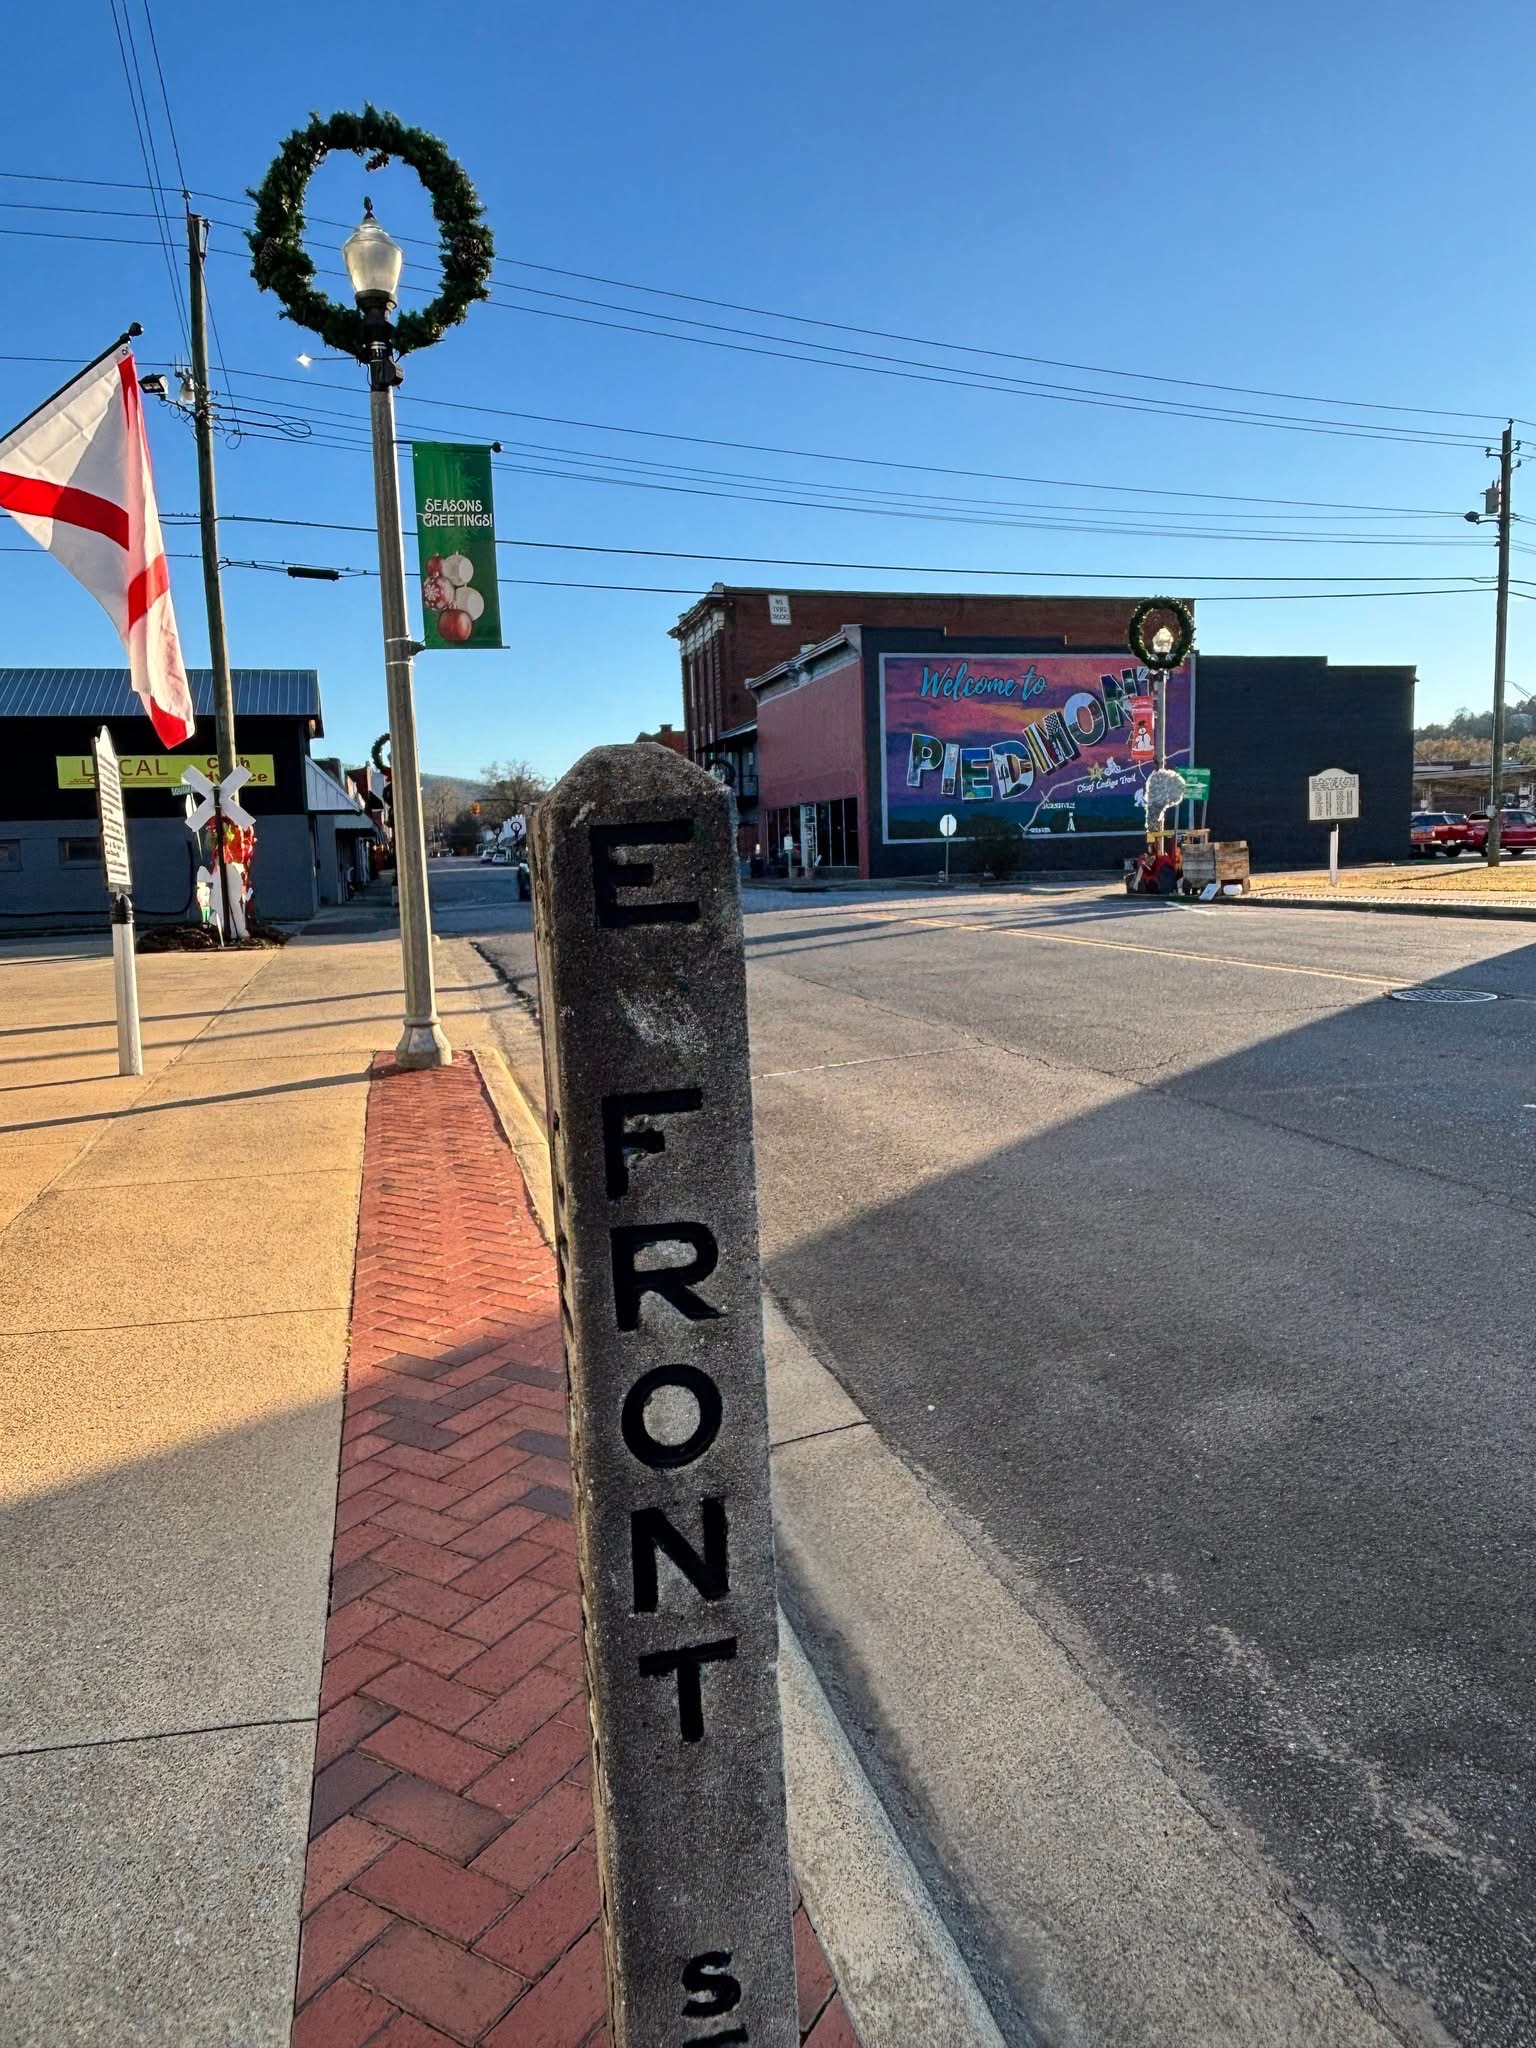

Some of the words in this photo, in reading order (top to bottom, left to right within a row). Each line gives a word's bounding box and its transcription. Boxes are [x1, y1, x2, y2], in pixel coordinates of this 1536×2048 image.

[425, 498, 483, 512] SEASONS
[416, 512, 493, 528] GREETINGS!
[920, 662, 1018, 700] Welcome
[1021, 666, 1047, 700] to
[81, 759, 169, 777] LCAL
[592, 817, 701, 928] E
[602, 1088, 738, 1742] FRONT
